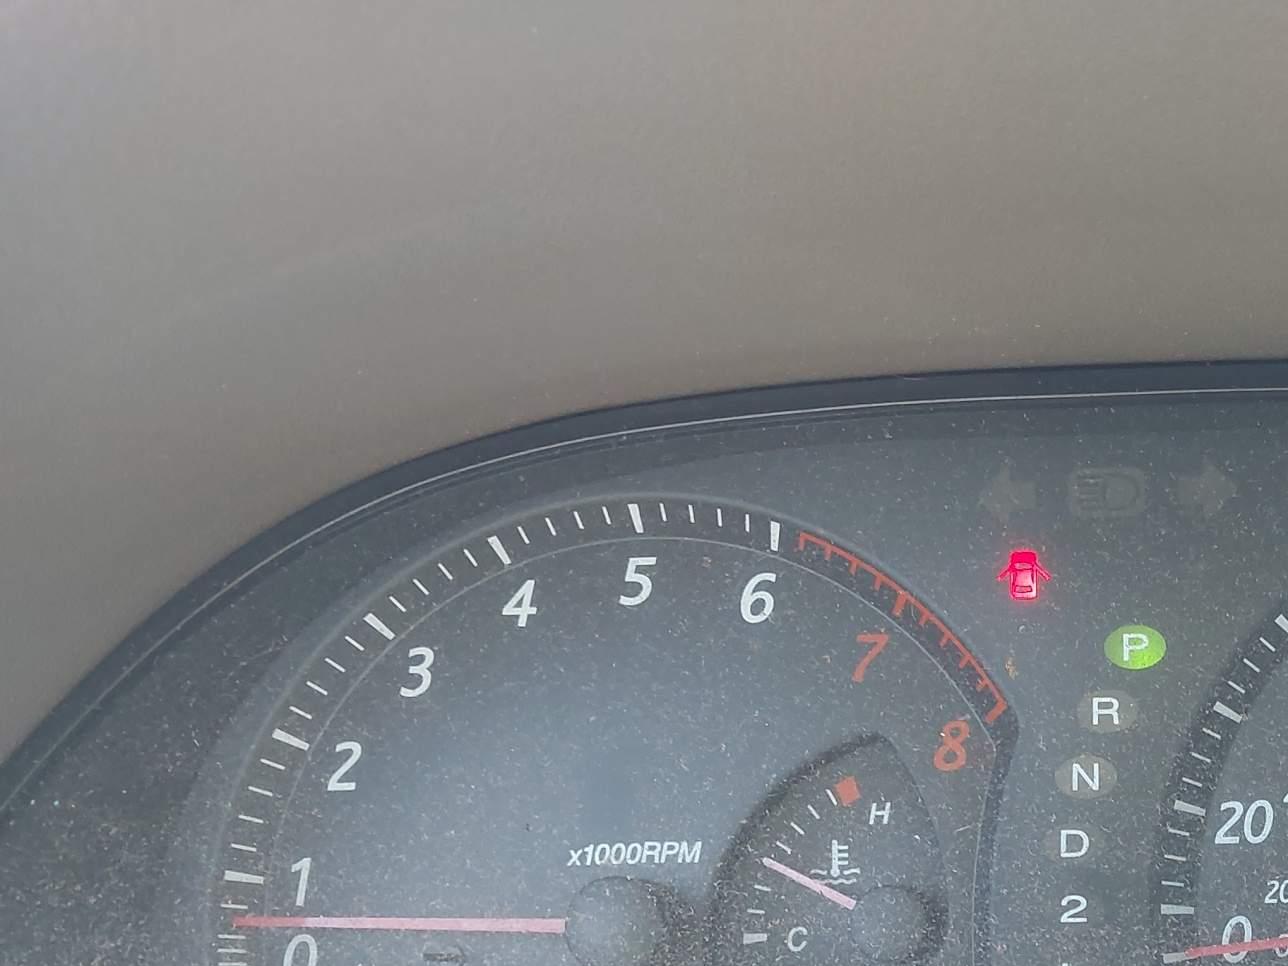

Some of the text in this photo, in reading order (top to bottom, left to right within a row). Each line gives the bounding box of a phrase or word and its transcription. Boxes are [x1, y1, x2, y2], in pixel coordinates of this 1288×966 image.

[502, 580, 537, 627] 4
[619, 557, 656, 606] 5
[740, 572, 777, 623] 6
[852, 634, 889, 682] 7
[1123, 633, 1149, 661] P
[399, 647, 435, 697] 3
[1093, 697, 1120, 725] R
[327, 741, 362, 791] 2
[933, 720, 970, 771] 8
[1071, 763, 1100, 791] N
[868, 804, 891, 825] H
[1214, 800, 1274, 844] 20
[567, 841, 701, 866] x1000RPM
[1061, 830, 1090, 858] D
[291, 858, 312, 906] 1
[1061, 897, 1087, 923] 2
[787, 928, 808, 952] C
[1222, 915, 1252, 963] 0
